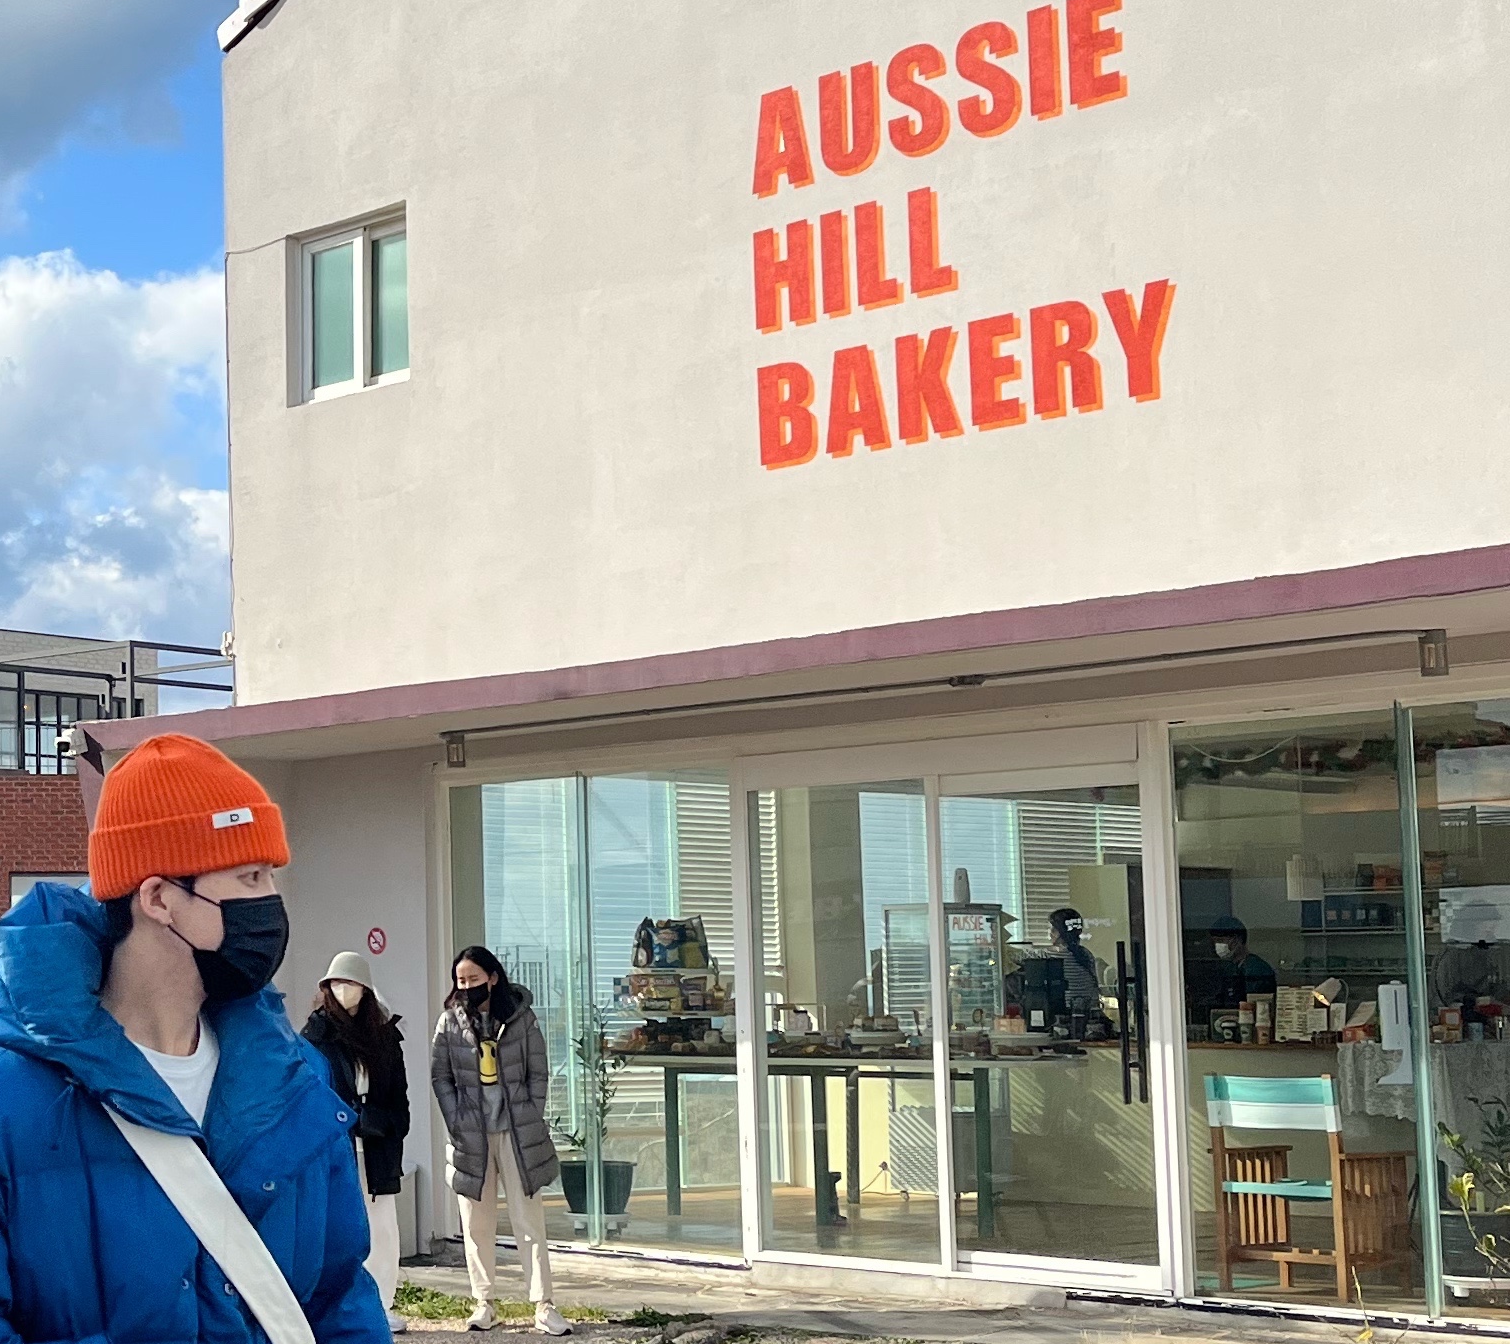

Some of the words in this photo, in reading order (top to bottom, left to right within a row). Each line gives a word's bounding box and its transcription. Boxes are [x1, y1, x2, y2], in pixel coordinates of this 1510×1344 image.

[753, 186, 958, 334] HILL
[757, 278, 1177, 470] BAKERY
[952, 915, 985, 932] AUSSIE
